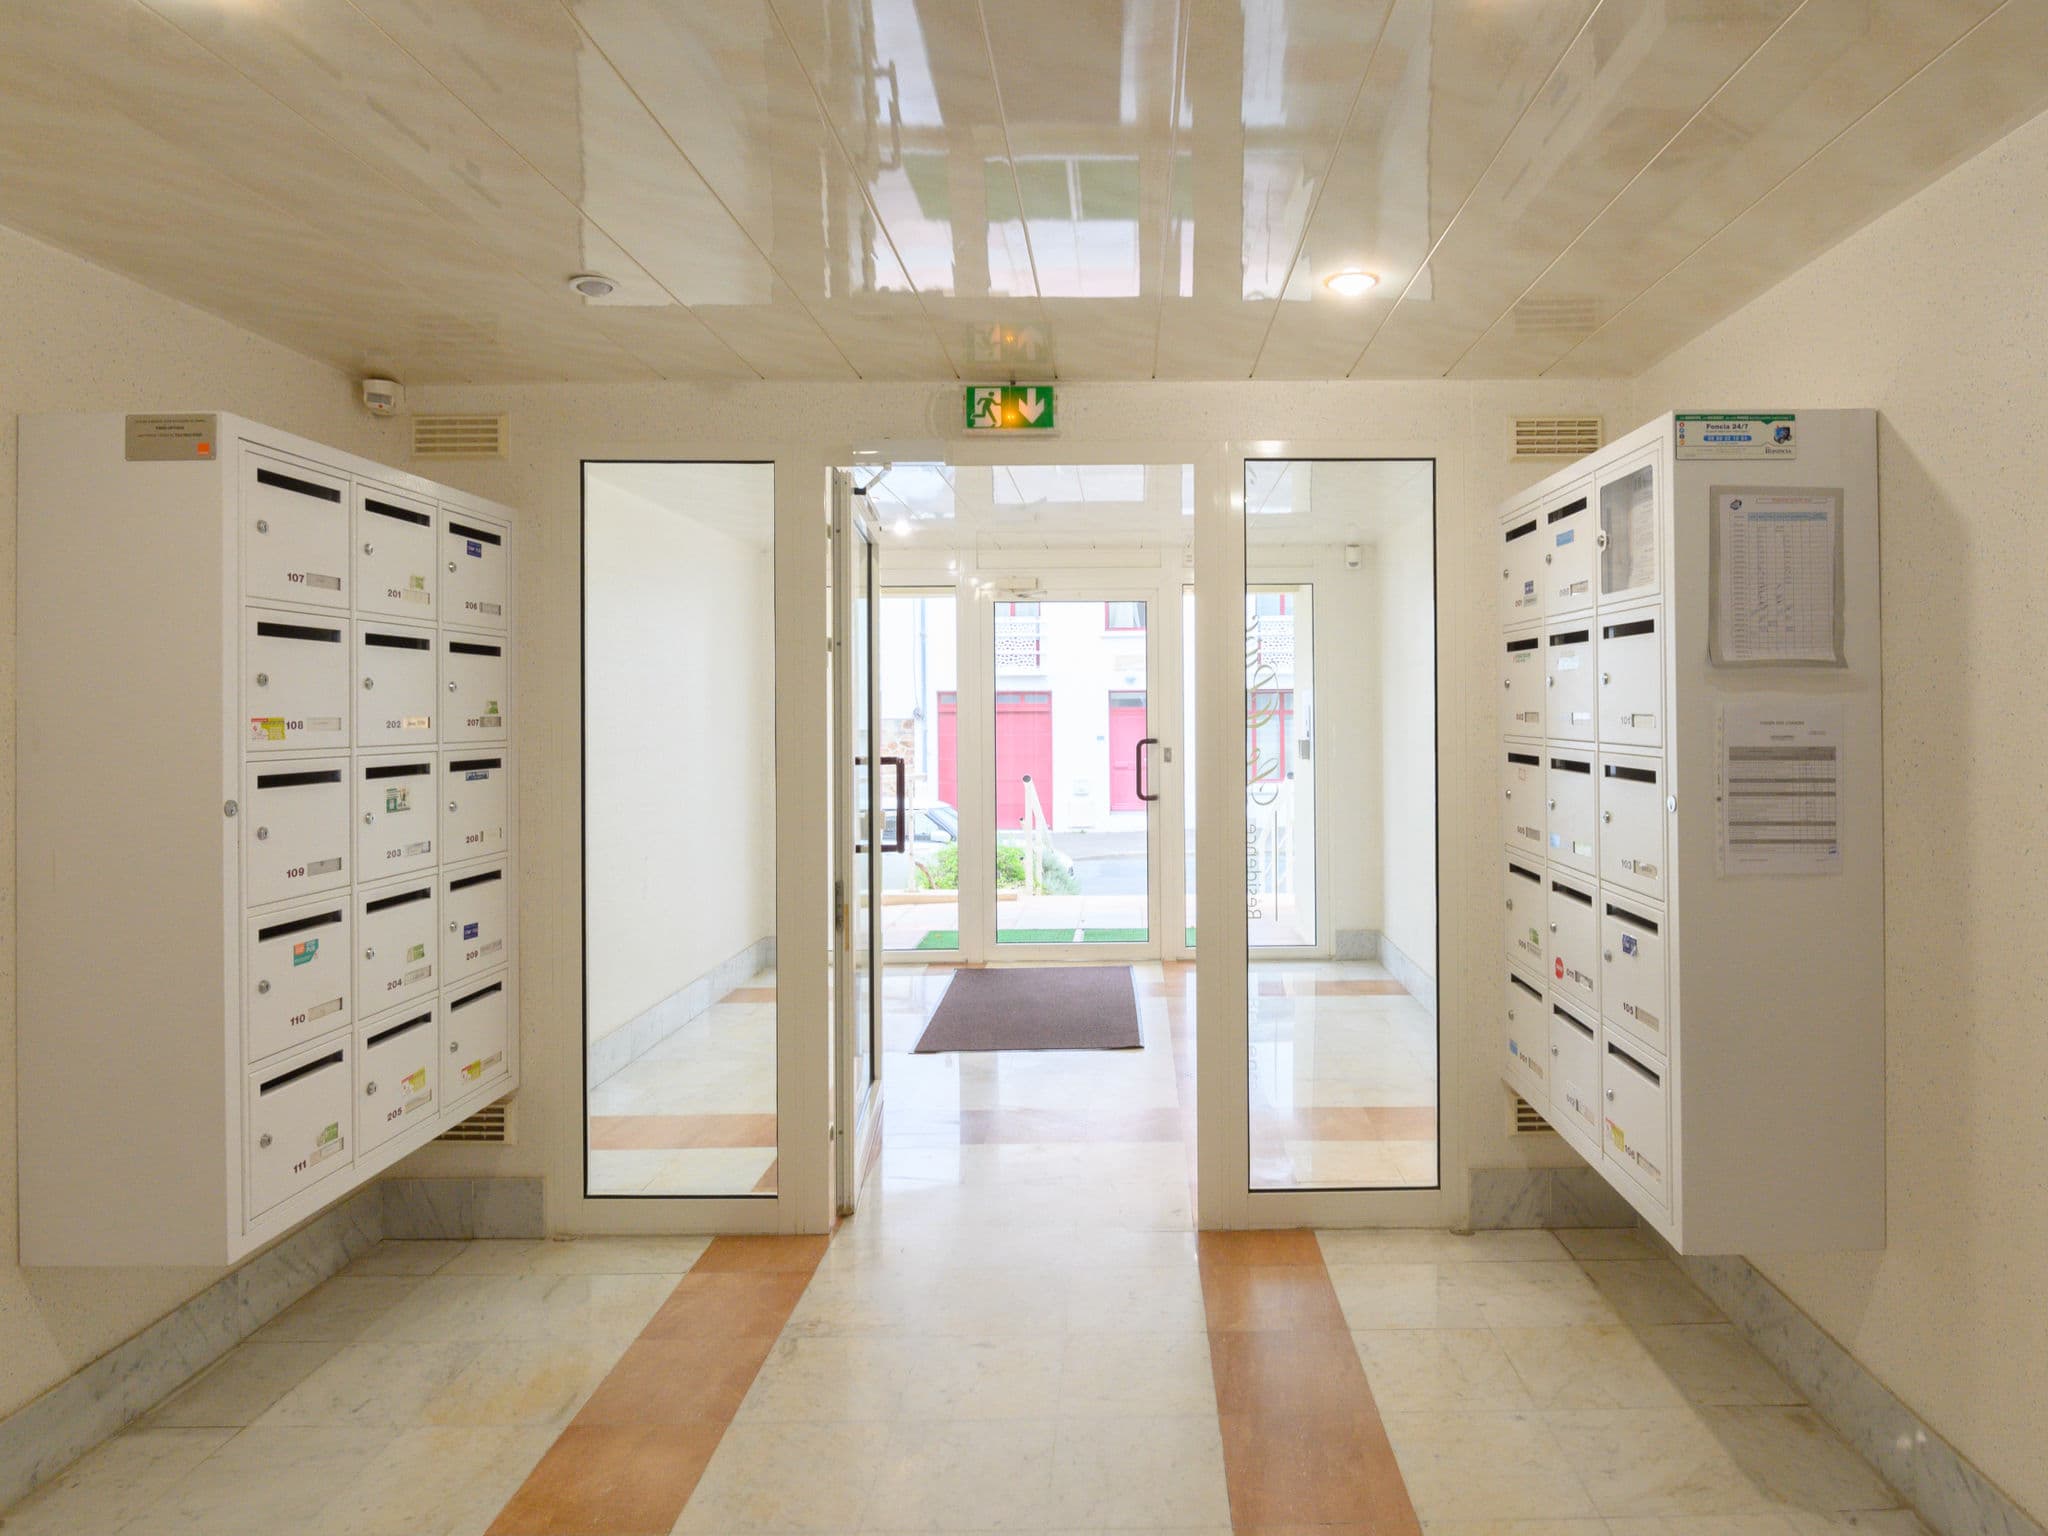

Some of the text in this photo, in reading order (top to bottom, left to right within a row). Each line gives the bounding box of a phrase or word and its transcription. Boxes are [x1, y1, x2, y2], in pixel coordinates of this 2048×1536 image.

[287, 572, 305, 583] 107
[387, 588, 402, 599] 201
[465, 601, 478, 611] 206
[286, 720, 303, 730] 108
[386, 720, 402, 729] 202
[466, 718, 479, 727] 207
[465, 834, 479, 843] 208
[386, 848, 402, 859] 203
[286, 866, 305, 878] 109
[466, 950, 479, 961] 209
[387, 978, 402, 991] 204
[290, 1014, 306, 1026] 110
[387, 1107, 403, 1122] 205
[293, 1160, 307, 1174] 111
